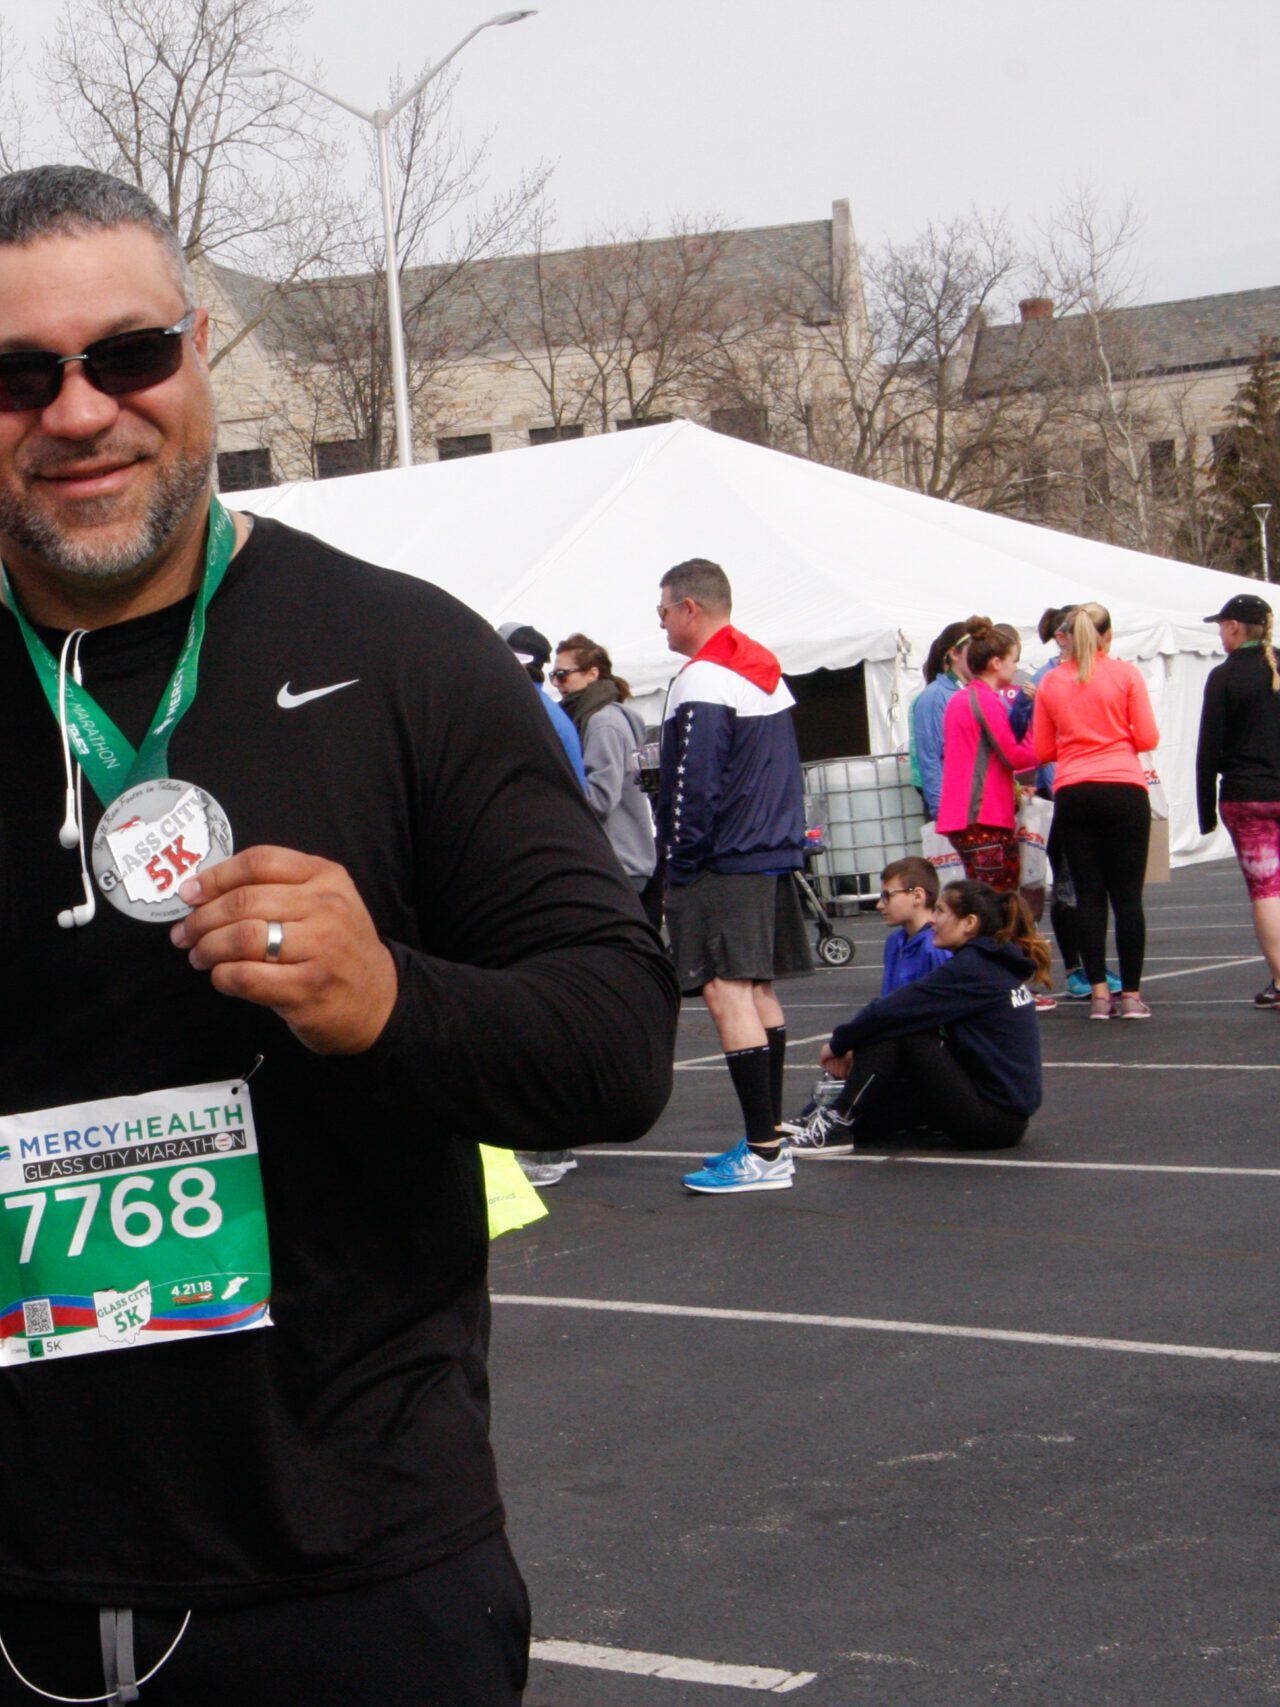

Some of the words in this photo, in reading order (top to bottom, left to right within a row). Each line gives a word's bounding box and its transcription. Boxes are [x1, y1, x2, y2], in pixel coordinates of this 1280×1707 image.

[71, 702, 120, 769] MARATHON
[157, 780, 182, 791] Toledo
[99, 832, 162, 892] GLASS
[160, 795, 208, 838] CITY
[146, 834, 202, 892] 5K
[24, 1155, 84, 1181] GLASS
[89, 1149, 129, 1169] CITY
[4, 1167, 223, 1265] 7768
[97, 1297, 128, 1318] GLASS
[128, 1286, 150, 1303] CITY
[171, 1280, 213, 1297] 4.21.18
[114, 1304, 145, 1334] 5K
[46, 1340, 63, 1353] 5K
